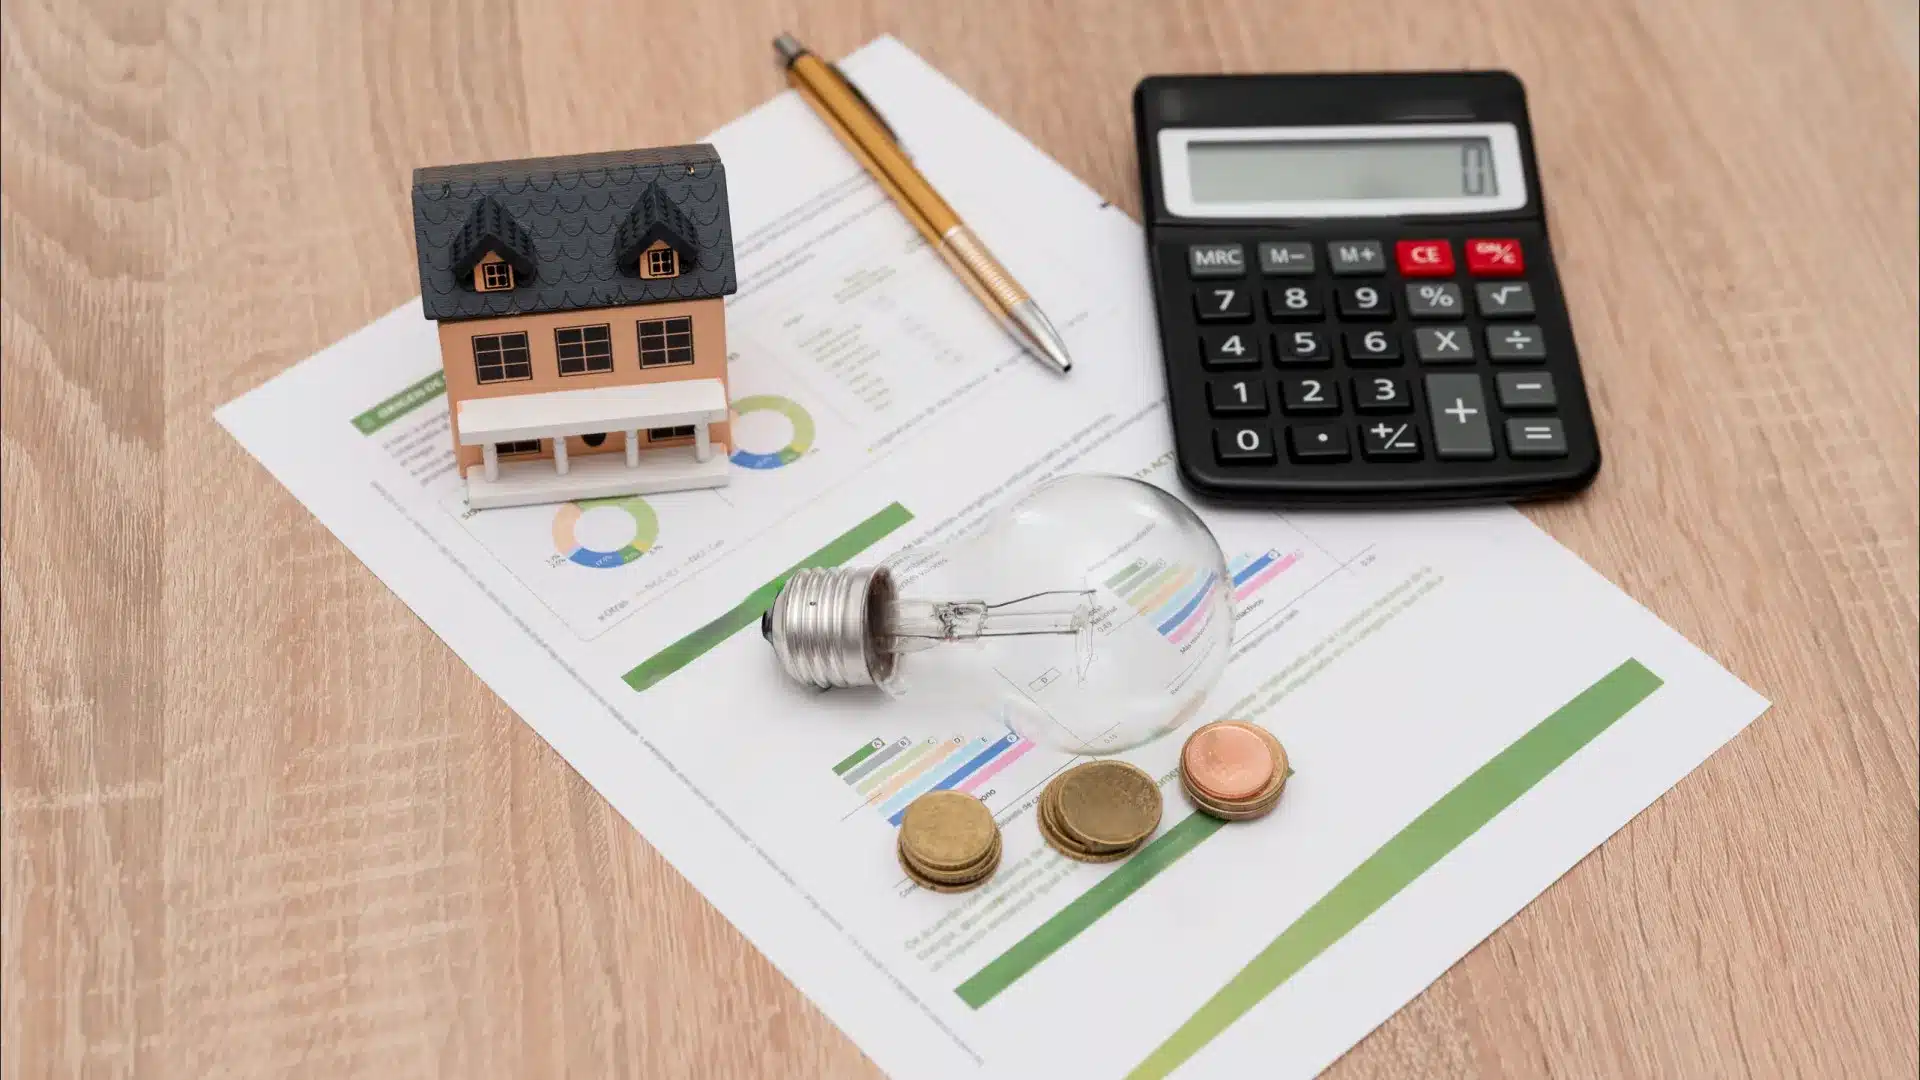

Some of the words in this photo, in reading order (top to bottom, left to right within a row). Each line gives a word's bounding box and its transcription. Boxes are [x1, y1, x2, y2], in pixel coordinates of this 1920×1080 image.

[1462, 144, 1484, 196] 0
[1195, 250, 1241, 265] MRC
[1340, 246, 1375, 262] M+
[1411, 246, 1440, 264] CE
[1214, 289, 1235, 311] 7
[1285, 288, 1308, 308] 8
[1355, 288, 1378, 308] 9
[1420, 286, 1454, 307] %
[1221, 336, 1245, 355] 4
[1294, 332, 1316, 353] 5
[1364, 332, 1387, 352] 6
[1233, 382, 1248, 403] 1
[1302, 380, 1324, 401] 2
[1374, 379, 1396, 400] 3
[1445, 399, 1478, 424] +
[1237, 430, 1259, 450] 0
[1524, 426, 1553, 439] =
